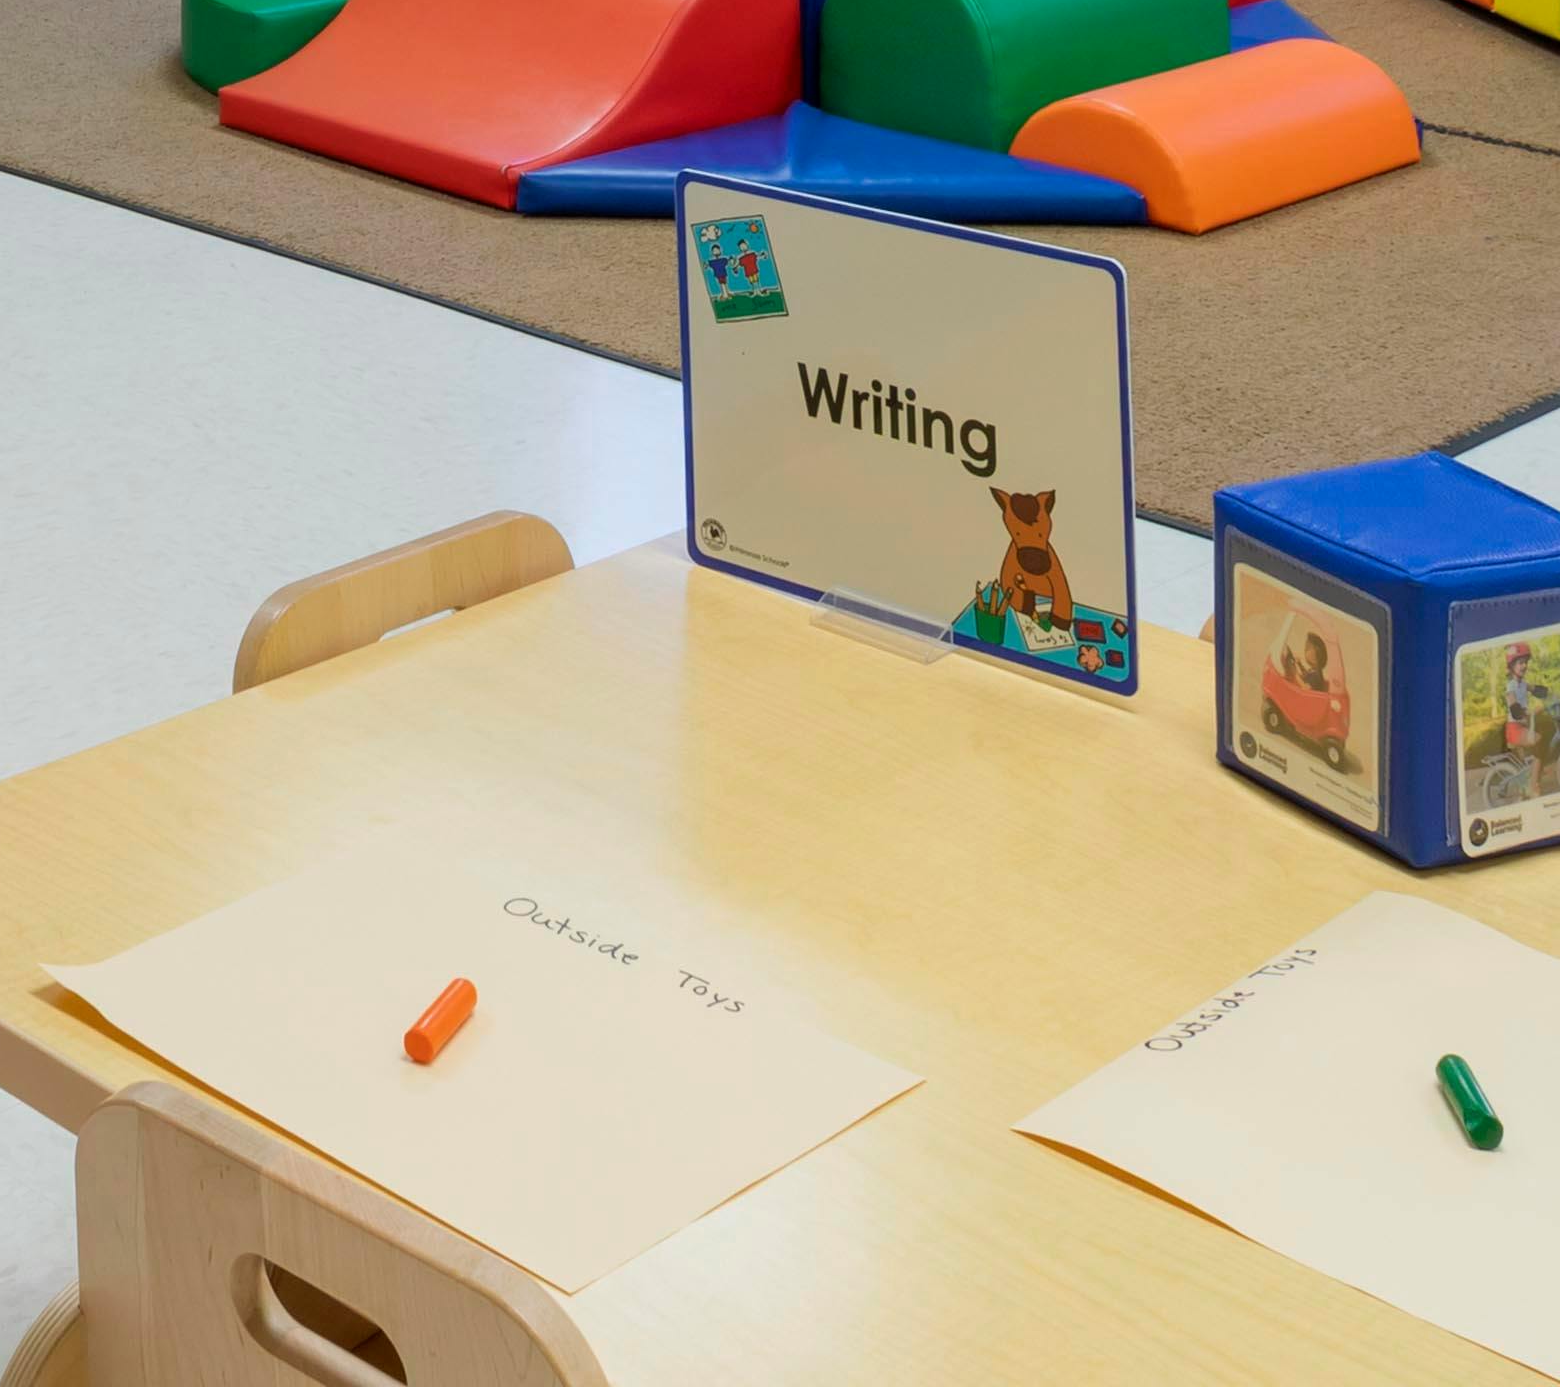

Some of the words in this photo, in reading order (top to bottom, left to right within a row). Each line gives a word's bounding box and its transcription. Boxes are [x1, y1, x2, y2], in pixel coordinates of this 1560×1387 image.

[797, 362, 998, 478] Writing
[504, 897, 639, 965] Outside
[679, 970, 745, 1013] Toys
[1144, 991, 1255, 1051] Outside
[1248, 949, 1317, 978] Toys
